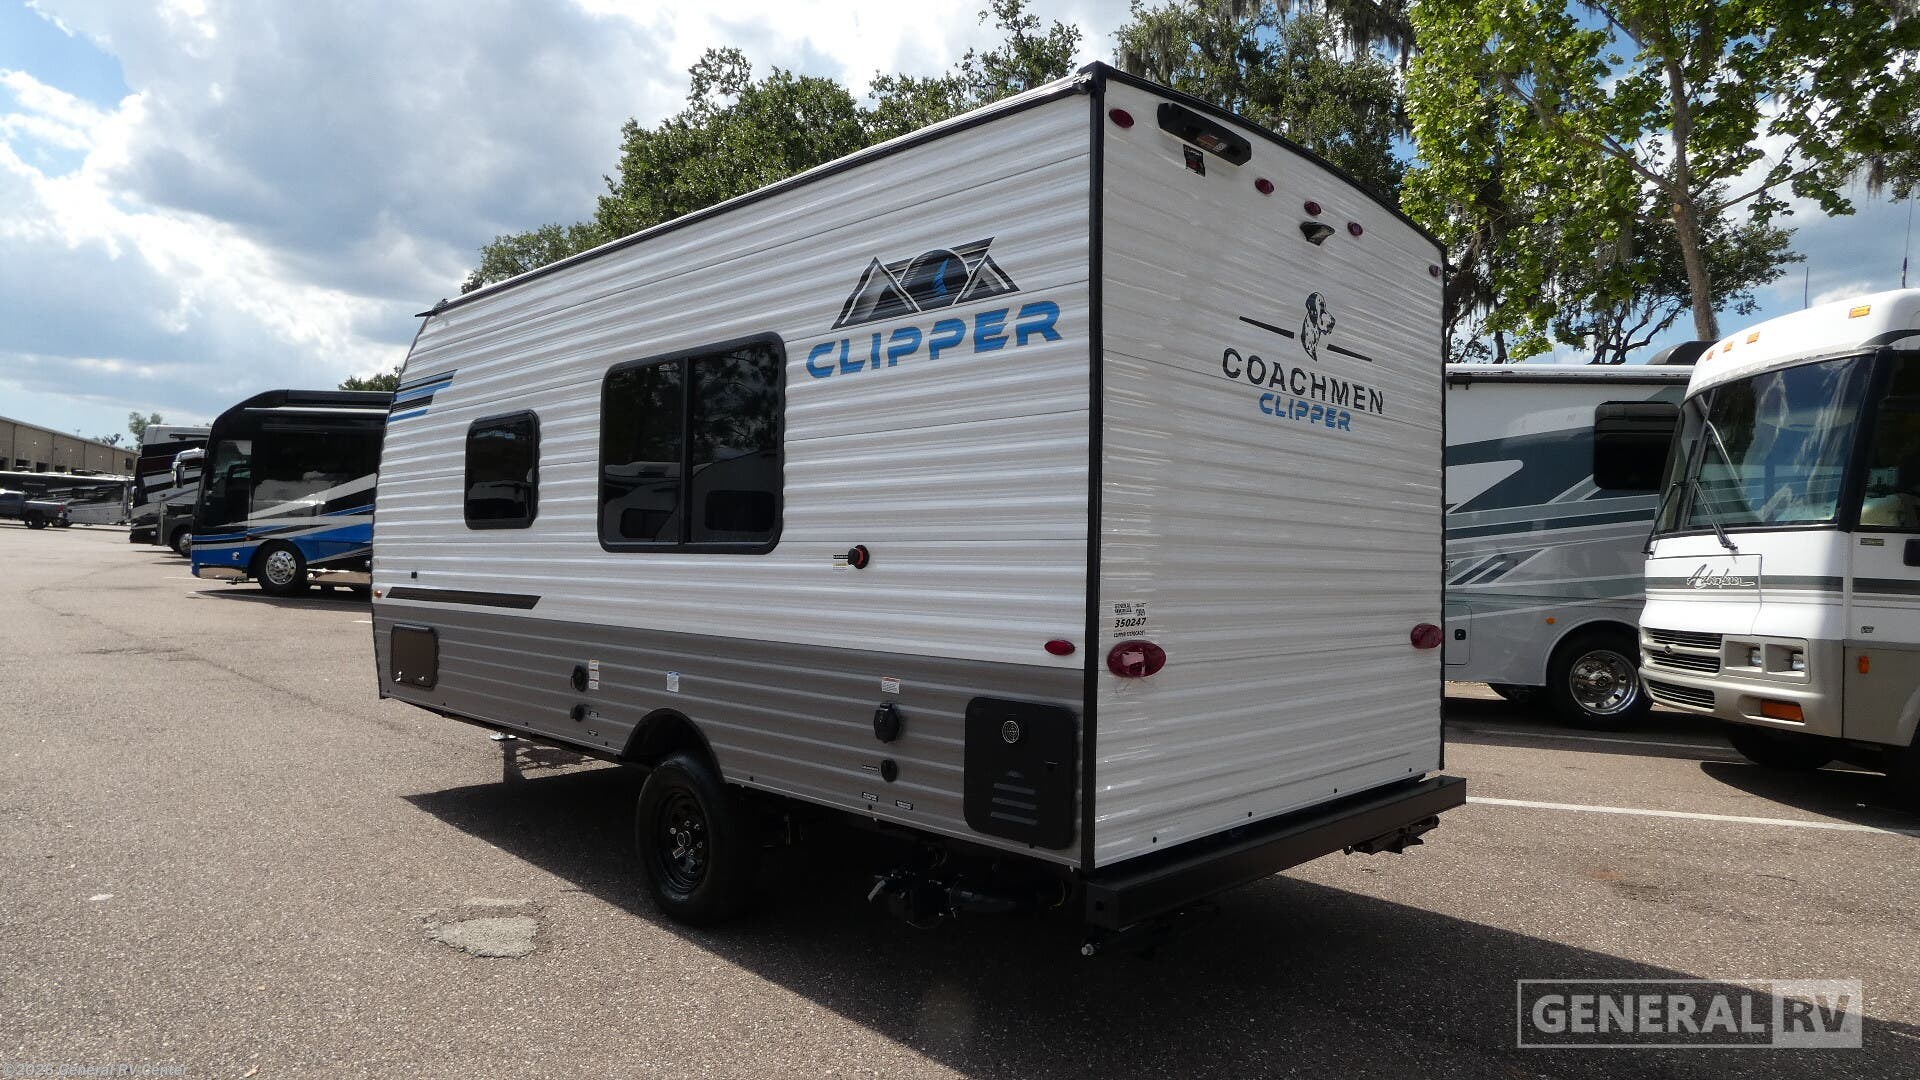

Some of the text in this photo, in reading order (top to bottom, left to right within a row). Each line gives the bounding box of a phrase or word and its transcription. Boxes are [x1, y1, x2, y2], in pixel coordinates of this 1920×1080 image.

[805, 300, 1062, 379] CLIPPER
[1222, 347, 1384, 415] COACHMEN
[1259, 392, 1351, 432] CLIPPER
[1114, 617, 1147, 628] 350247
